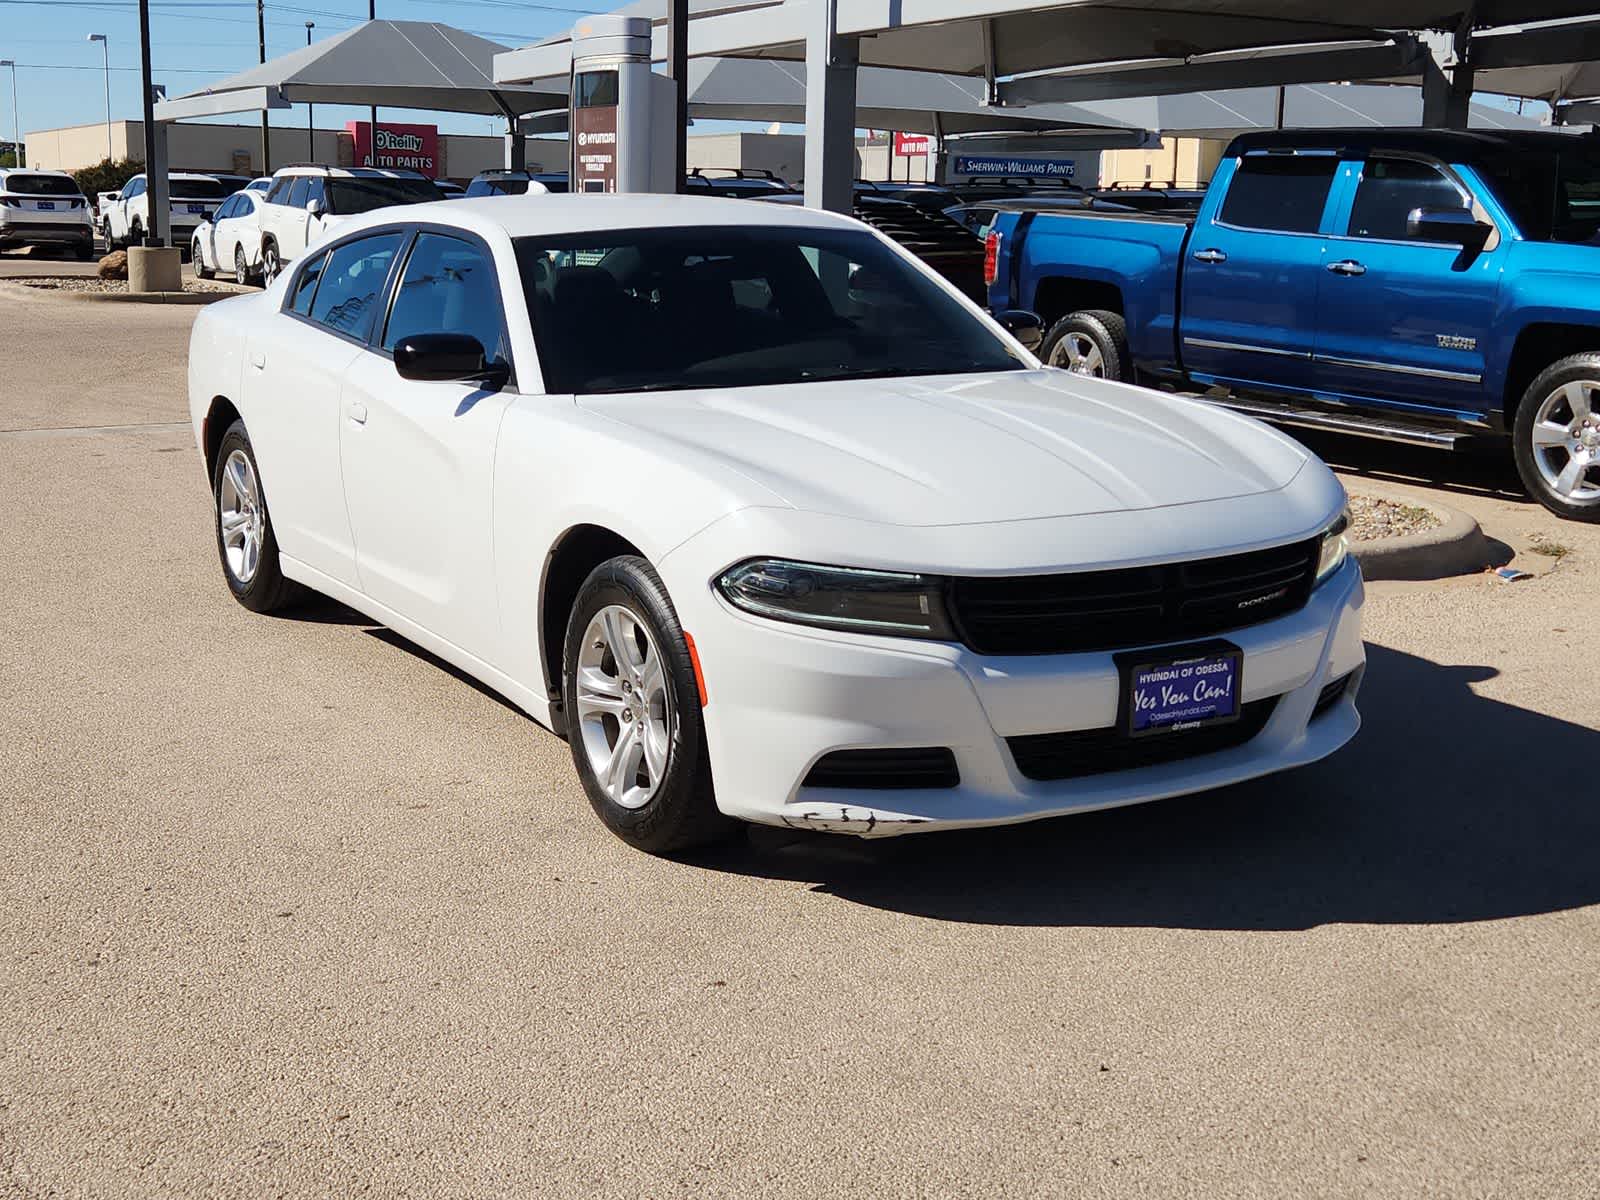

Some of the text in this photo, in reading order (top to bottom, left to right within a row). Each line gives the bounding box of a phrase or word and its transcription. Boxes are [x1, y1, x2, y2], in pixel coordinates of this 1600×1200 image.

[376, 130, 423, 152] O'Reilly
[587, 132, 616, 144] HYUNDAI
[364, 156, 433, 168] ATO PARTS
[1047, 163, 1074, 175] PAINTS
[1139, 663, 1228, 684] HYUNDAI OF ODESSA
[1134, 674, 1232, 712] Yes You Can!
